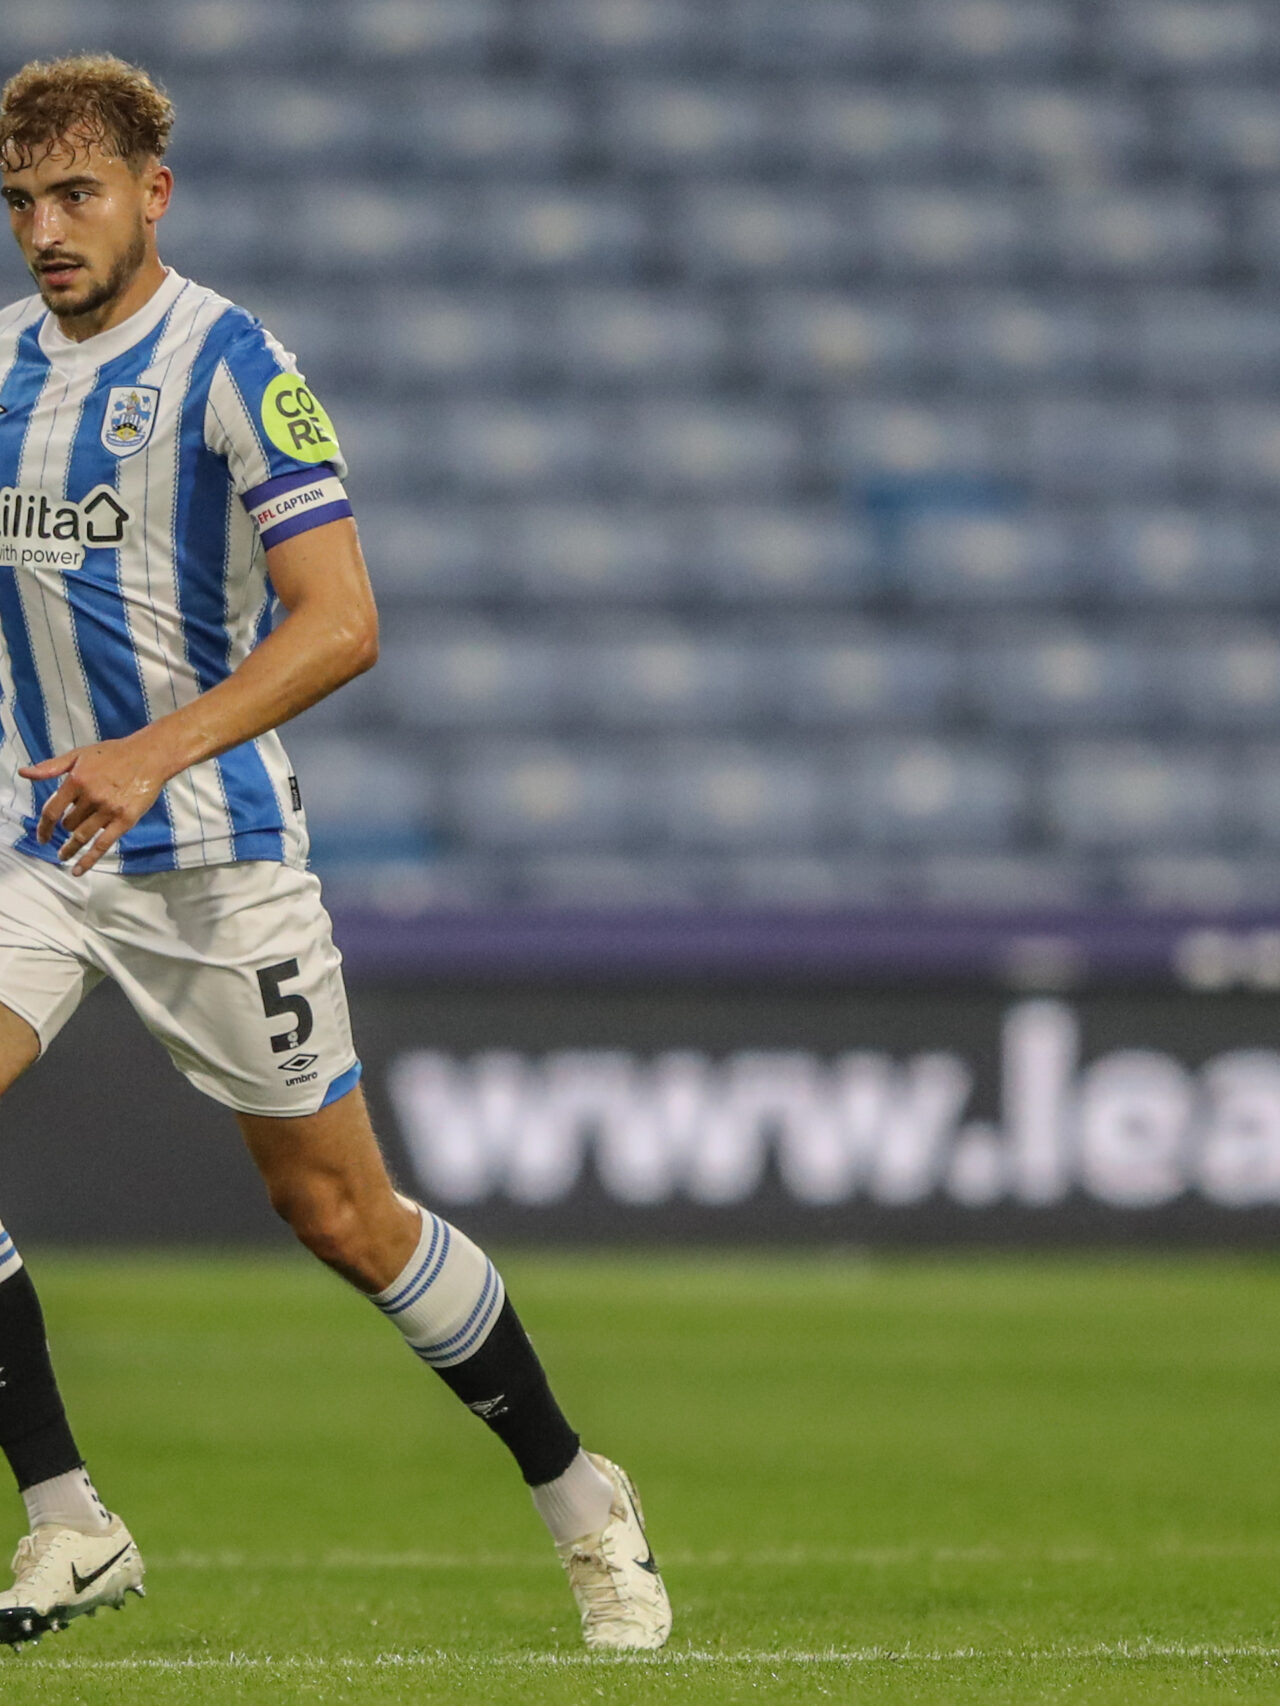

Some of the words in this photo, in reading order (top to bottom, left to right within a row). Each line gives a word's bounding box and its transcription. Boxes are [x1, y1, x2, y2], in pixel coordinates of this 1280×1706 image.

[275, 387, 315, 418] CO
[257, 508, 276, 525] EFL
[275, 488, 324, 515] CAPTAIN
[21, 549, 81, 566] power
[256, 957, 313, 1053] 5
[285, 1071, 319, 1087] umbro
